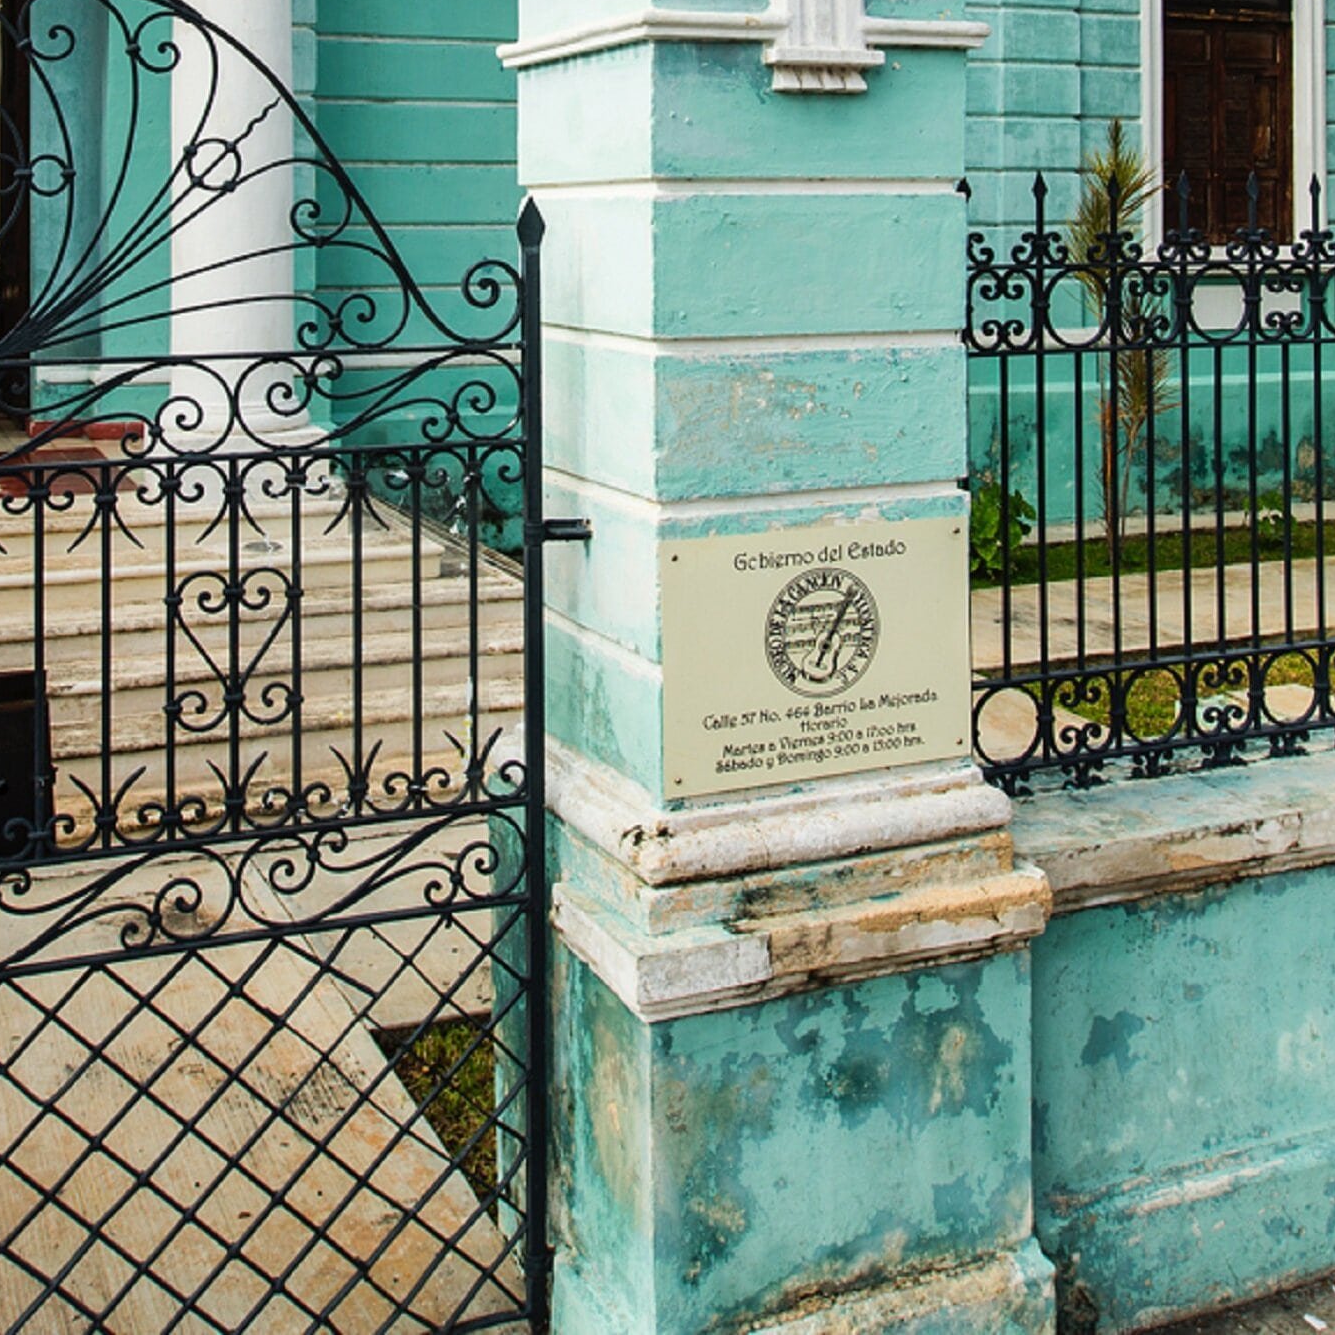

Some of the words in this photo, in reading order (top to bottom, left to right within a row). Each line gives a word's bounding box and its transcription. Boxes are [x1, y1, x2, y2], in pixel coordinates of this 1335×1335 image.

[734, 551, 814, 571] Gobierno
[818, 544, 842, 563] del
[848, 539, 906, 560] Estado
[704, 713, 737, 730] Calle
[760, 709, 781, 723] No.
[814, 701, 856, 717] Barrio
[860, 697, 876, 710] La
[878, 688, 937, 708] Mejorada
[800, 716, 847, 732] Horario
[723, 743, 765, 758] Martes
[766, 757, 775, 770] y
[777, 748, 832, 764] Domingo
